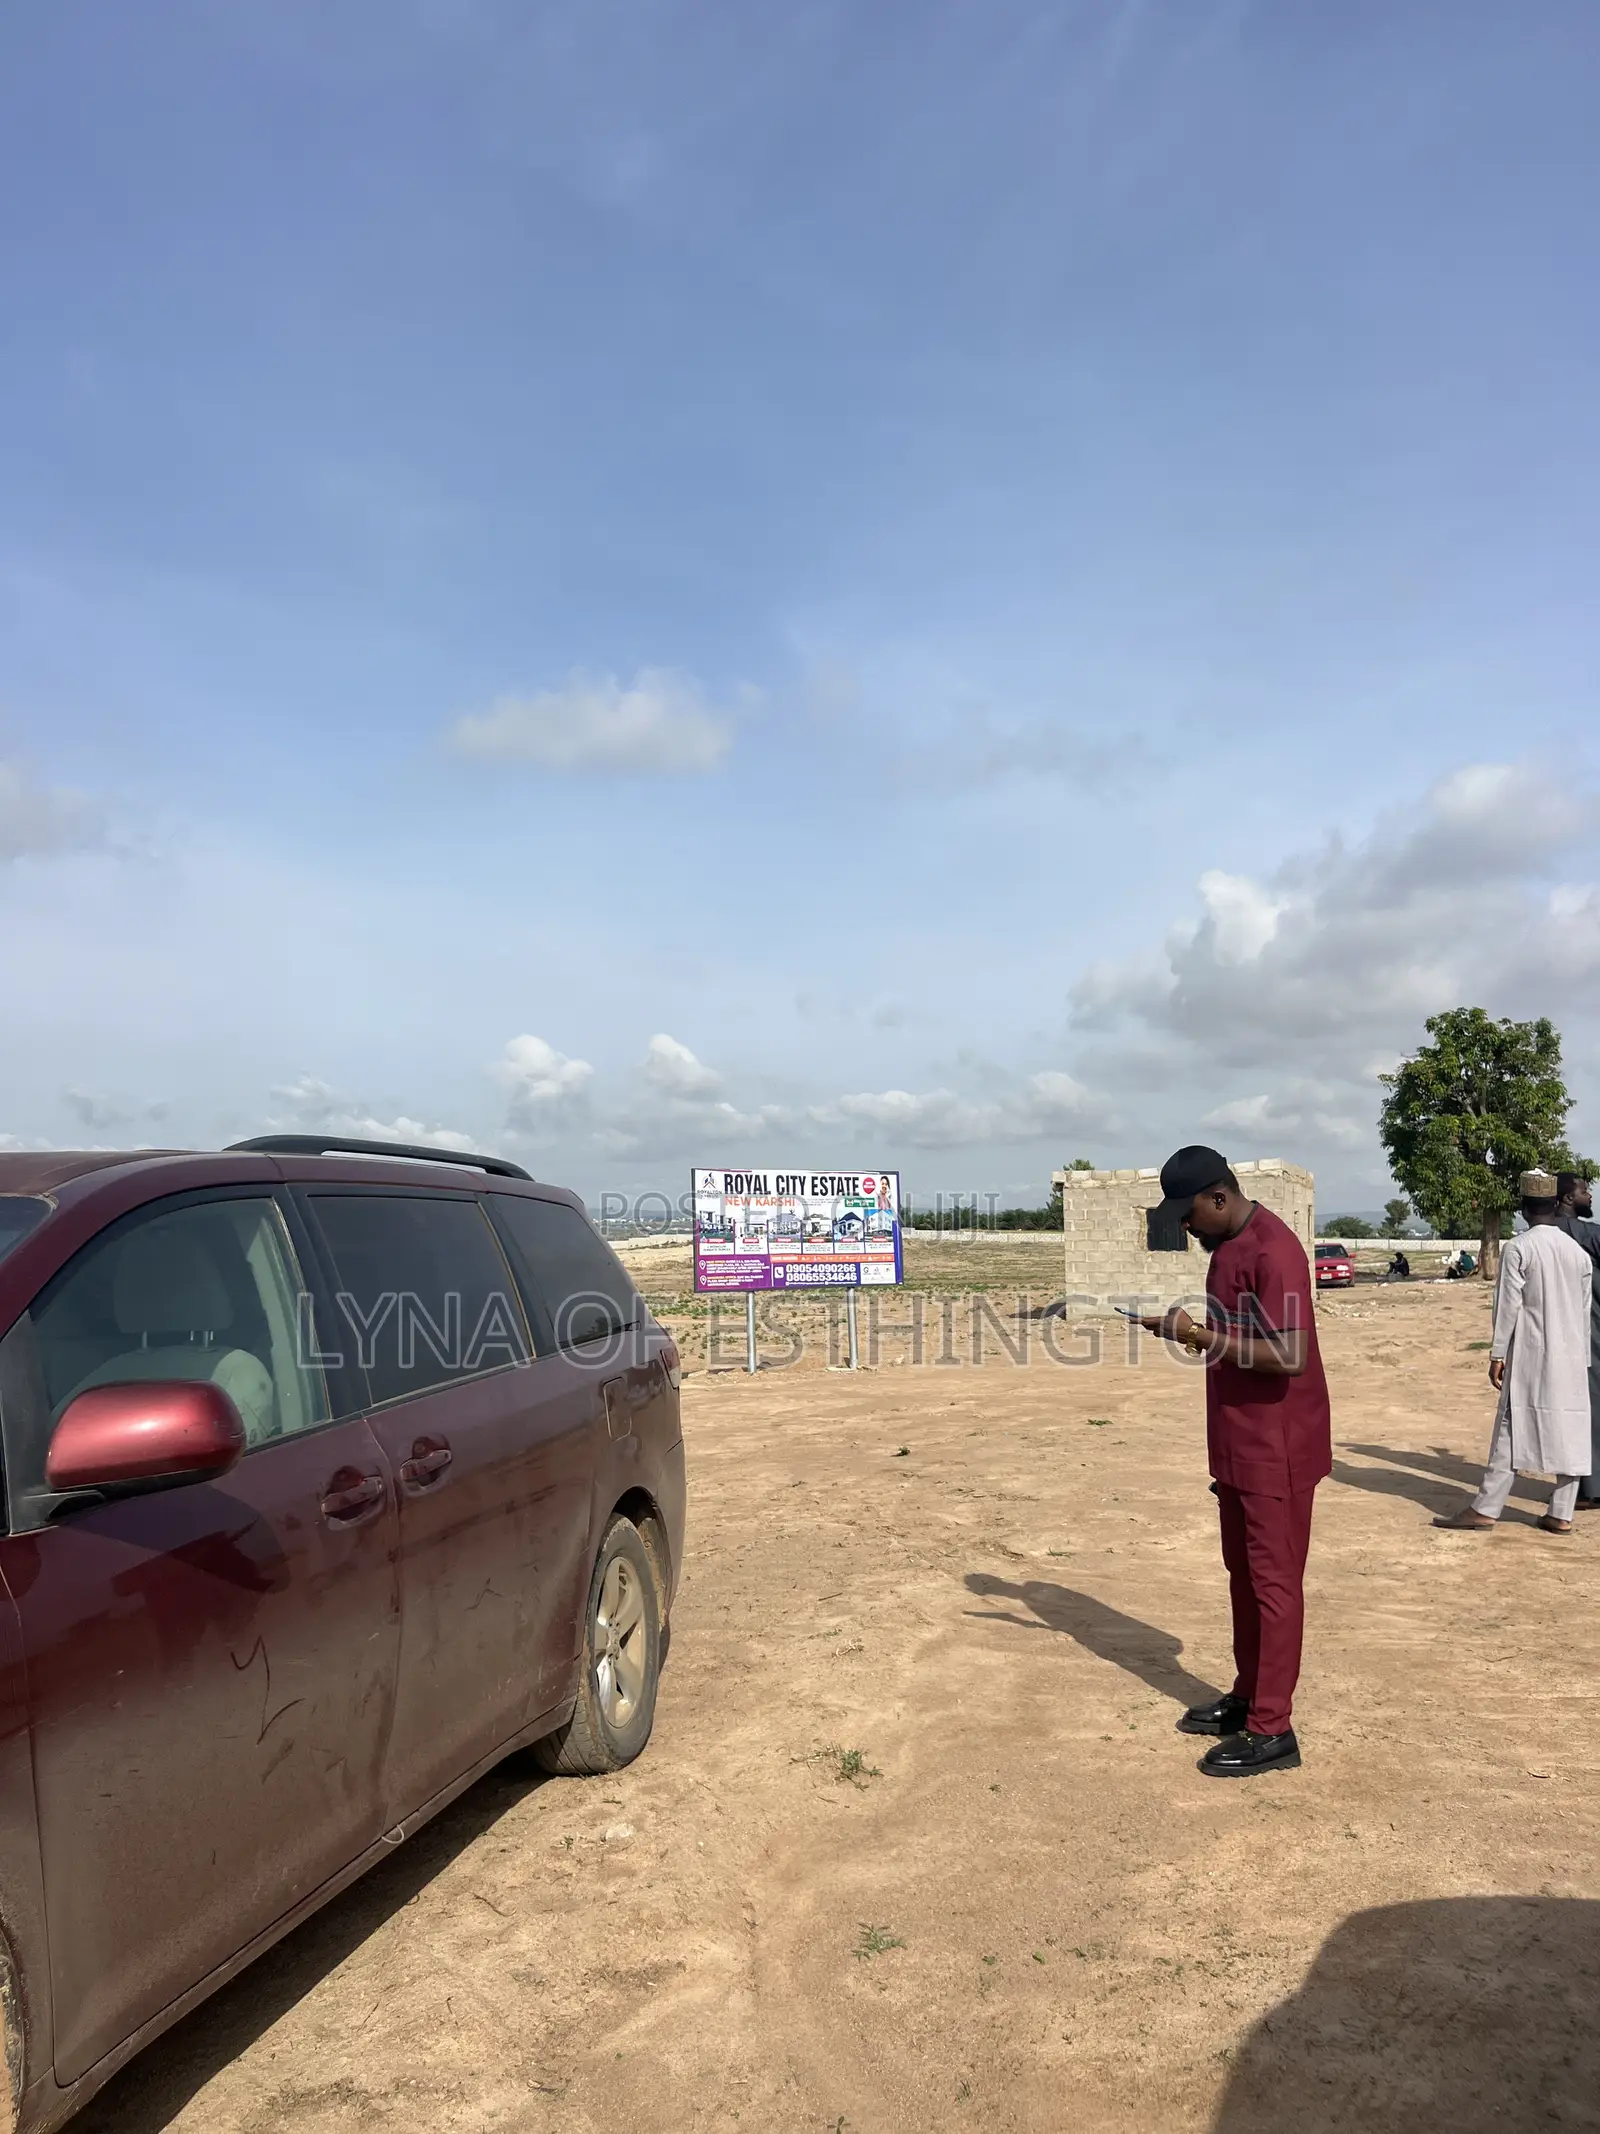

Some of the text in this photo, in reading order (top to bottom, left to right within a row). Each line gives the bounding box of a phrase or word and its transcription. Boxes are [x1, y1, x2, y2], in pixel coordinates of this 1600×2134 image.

[724, 1173, 860, 1197] ROYAL CITY ESTATE
[725, 1196, 751, 1206] NEW
[755, 1196, 795, 1207] KARSHI
[786, 1264, 856, 1273] 09054090266
[786, 1273, 857, 1282] 08065534646
